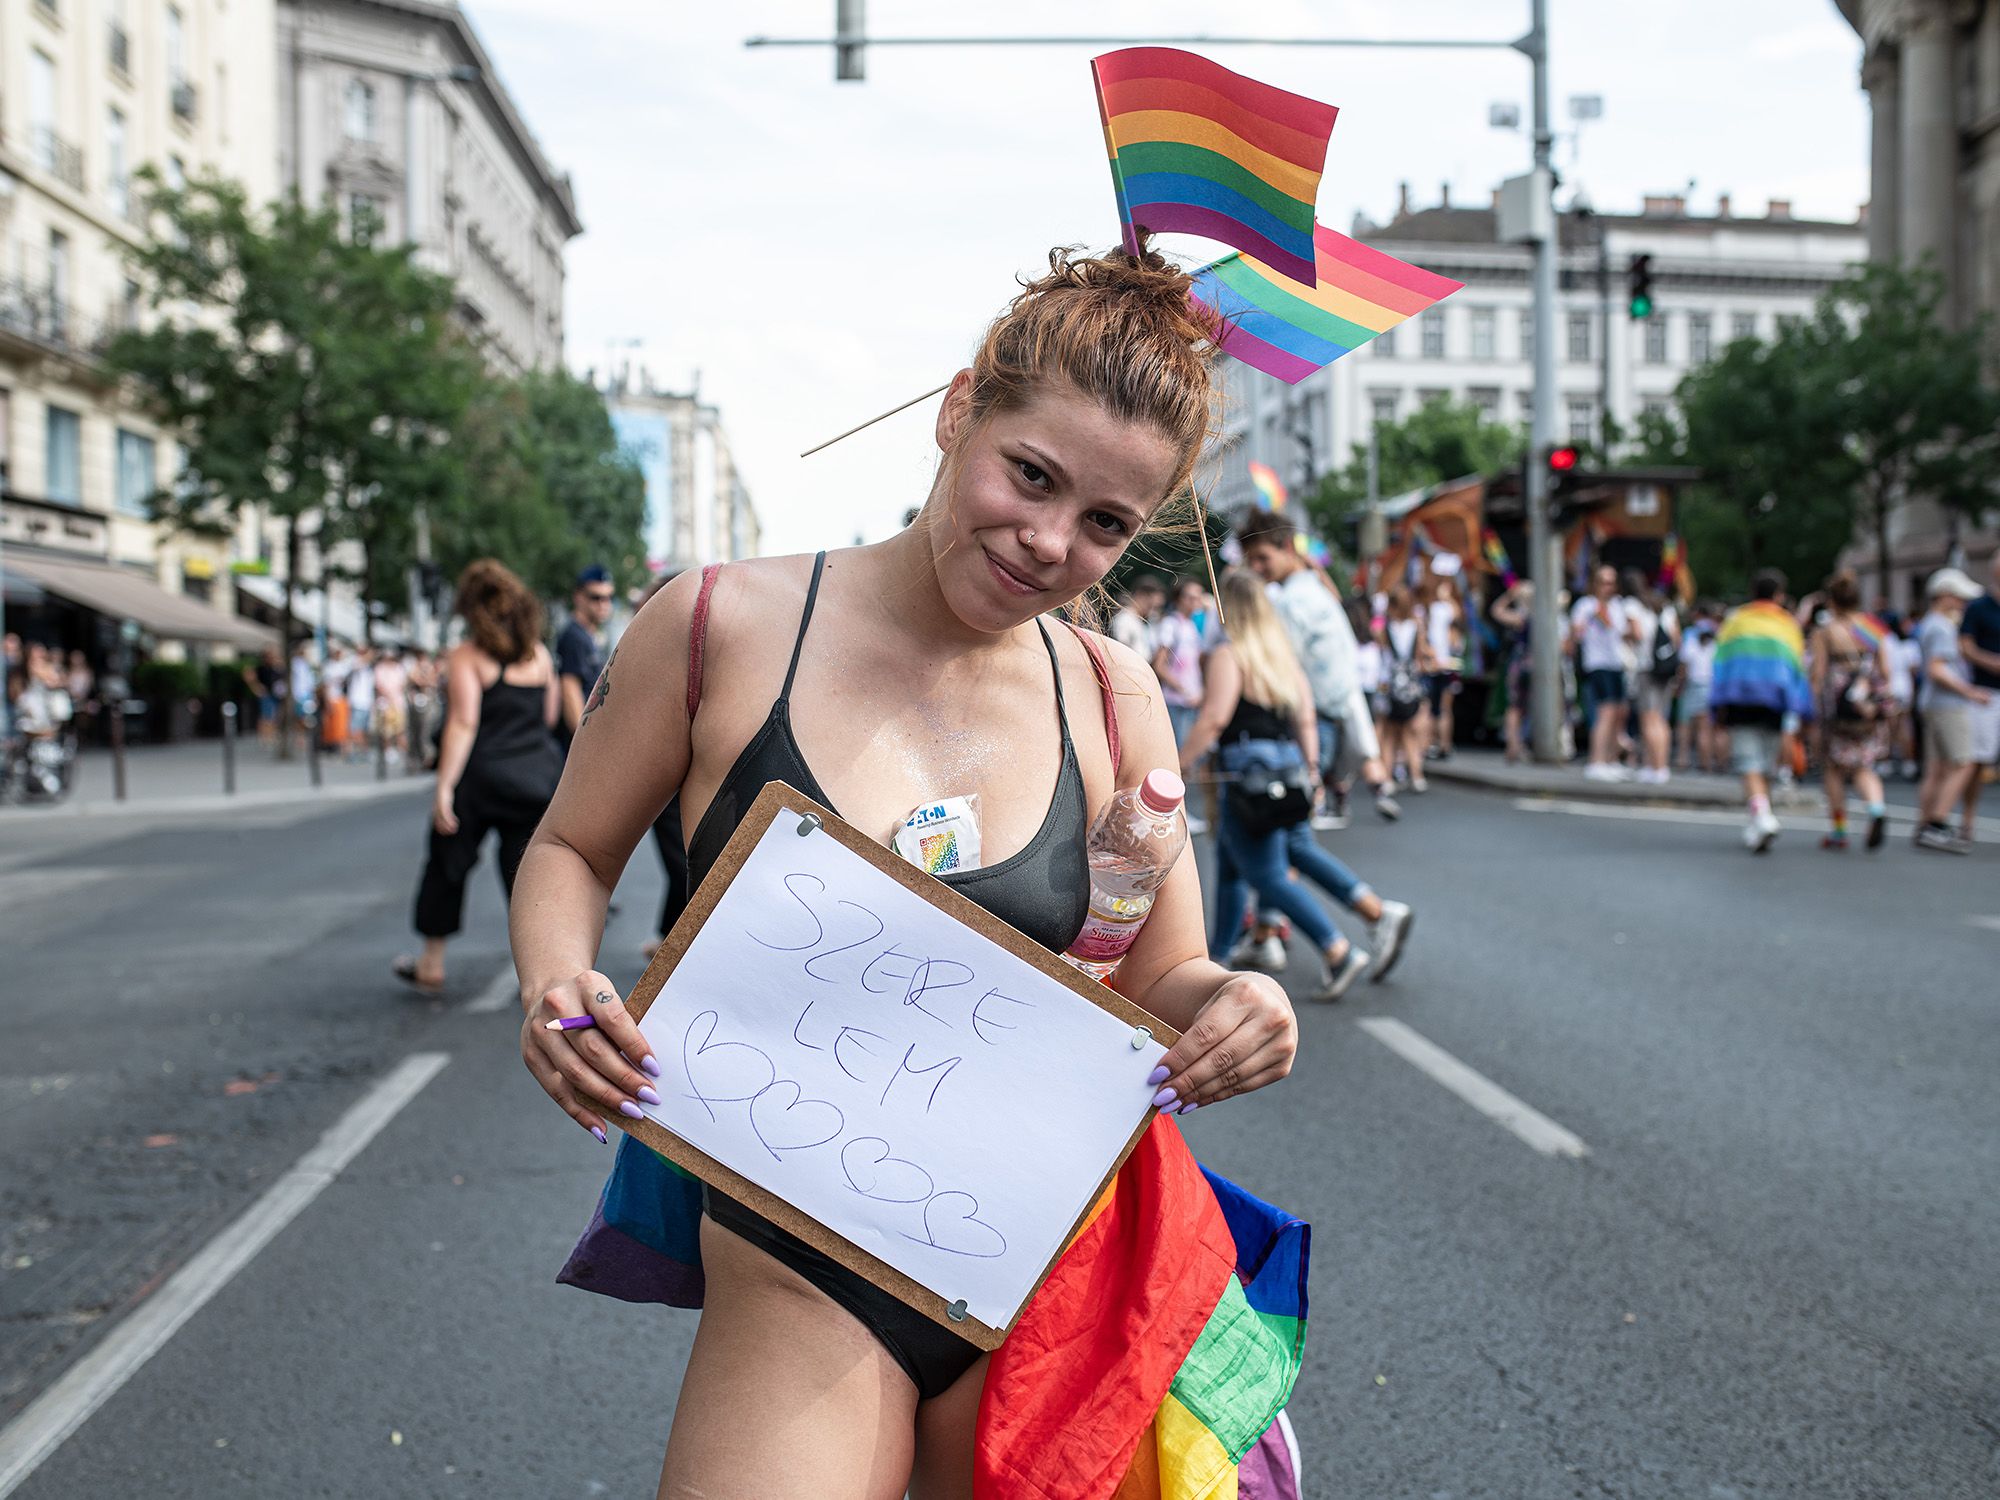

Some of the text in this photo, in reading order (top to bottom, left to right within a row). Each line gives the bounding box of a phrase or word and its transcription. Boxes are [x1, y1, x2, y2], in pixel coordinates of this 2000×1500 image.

[745, 872, 1037, 1045] SZERE
[1090, 927, 1122, 940] Super
[793, 1000, 963, 1114] LEM
